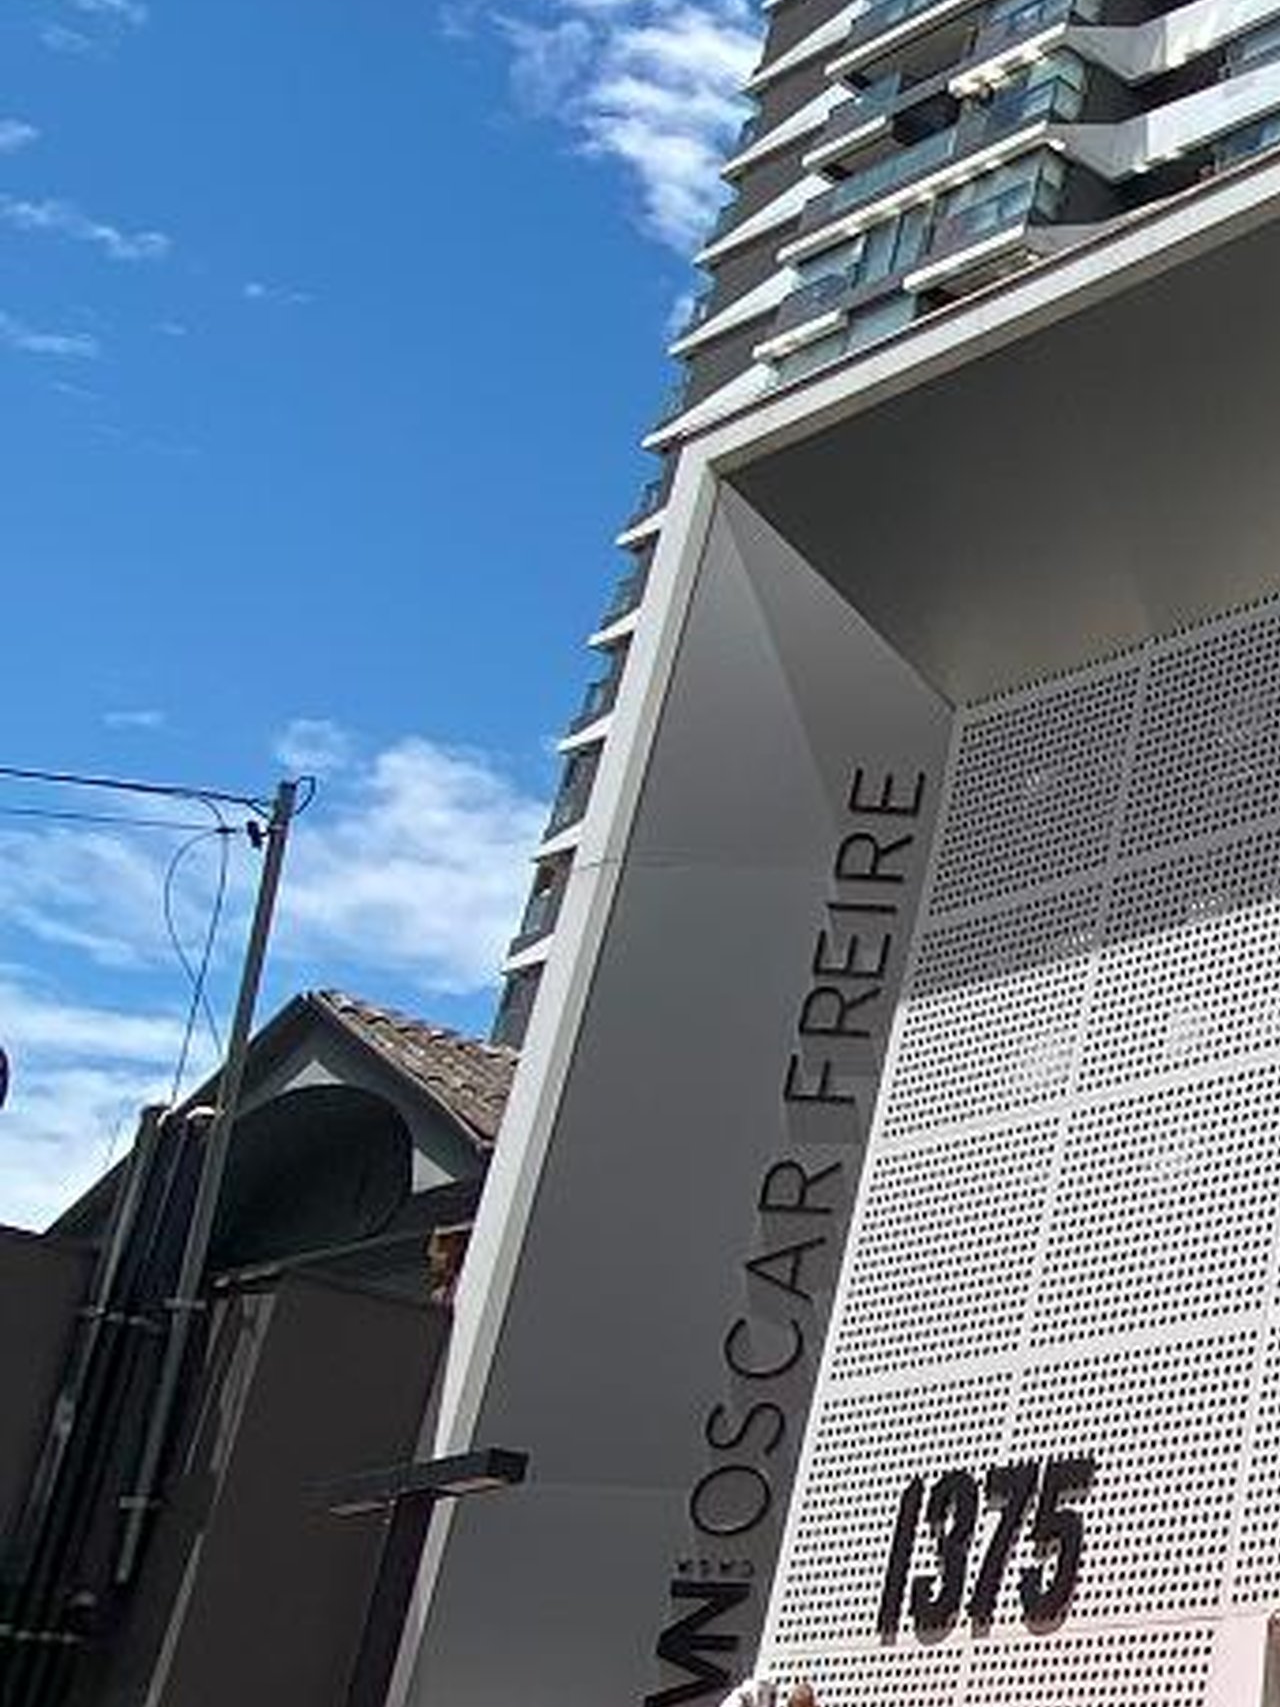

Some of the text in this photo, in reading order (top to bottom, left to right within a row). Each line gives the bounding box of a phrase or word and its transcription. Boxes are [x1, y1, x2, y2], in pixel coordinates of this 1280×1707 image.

[689, 1161, 842, 1537] OSCAR
[785, 767, 926, 1108] FREIRE
[877, 1457, 1096, 1645] 1375
